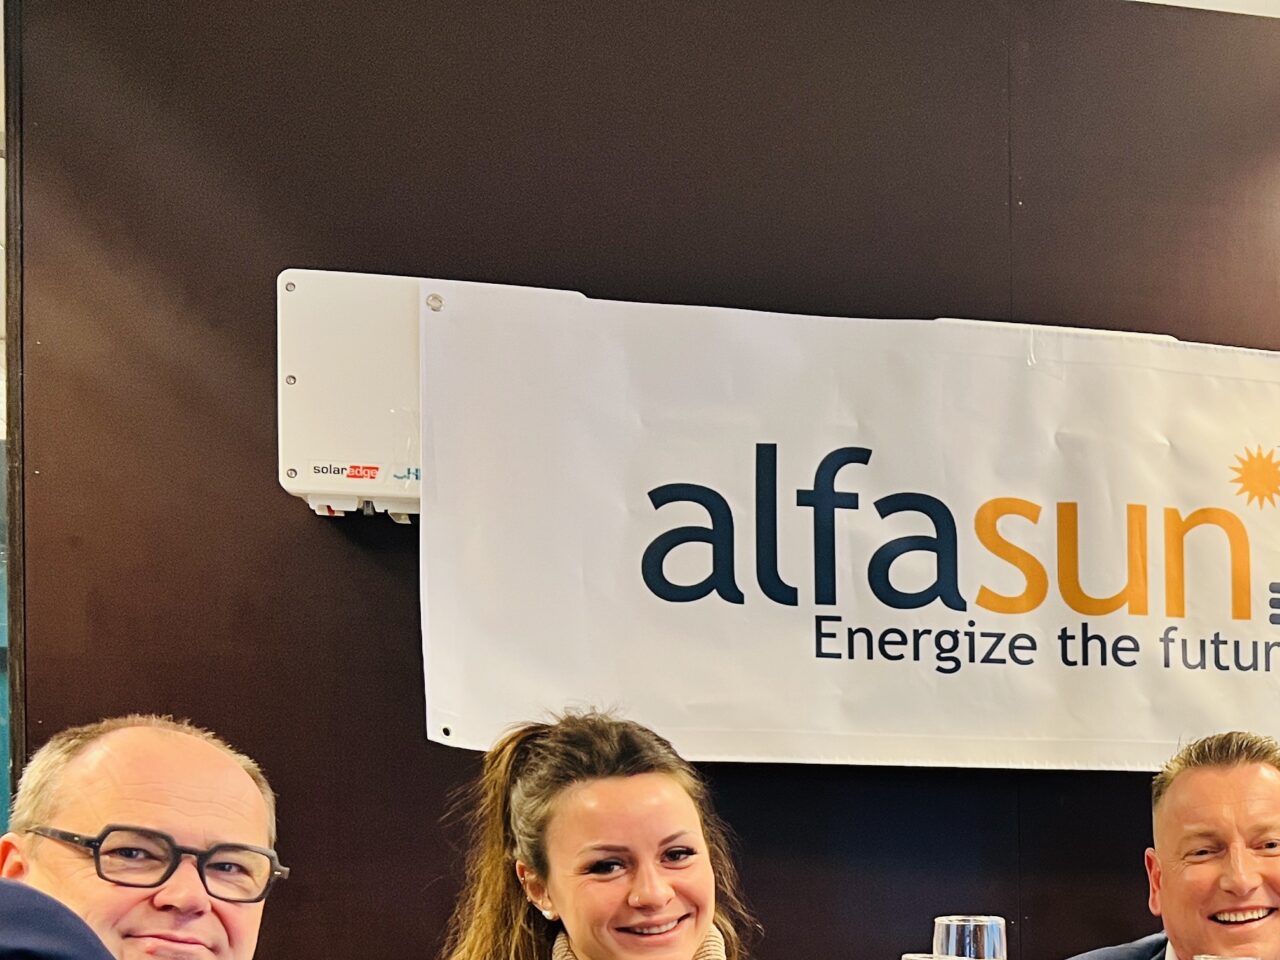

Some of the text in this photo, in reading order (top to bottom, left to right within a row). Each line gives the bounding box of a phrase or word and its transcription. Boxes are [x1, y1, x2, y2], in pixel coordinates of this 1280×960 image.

[313, 464, 380, 479] solaredge
[640, 442, 1253, 621] alfasun
[813, 614, 1038, 675] Energize
[1057, 625, 1141, 668] the
